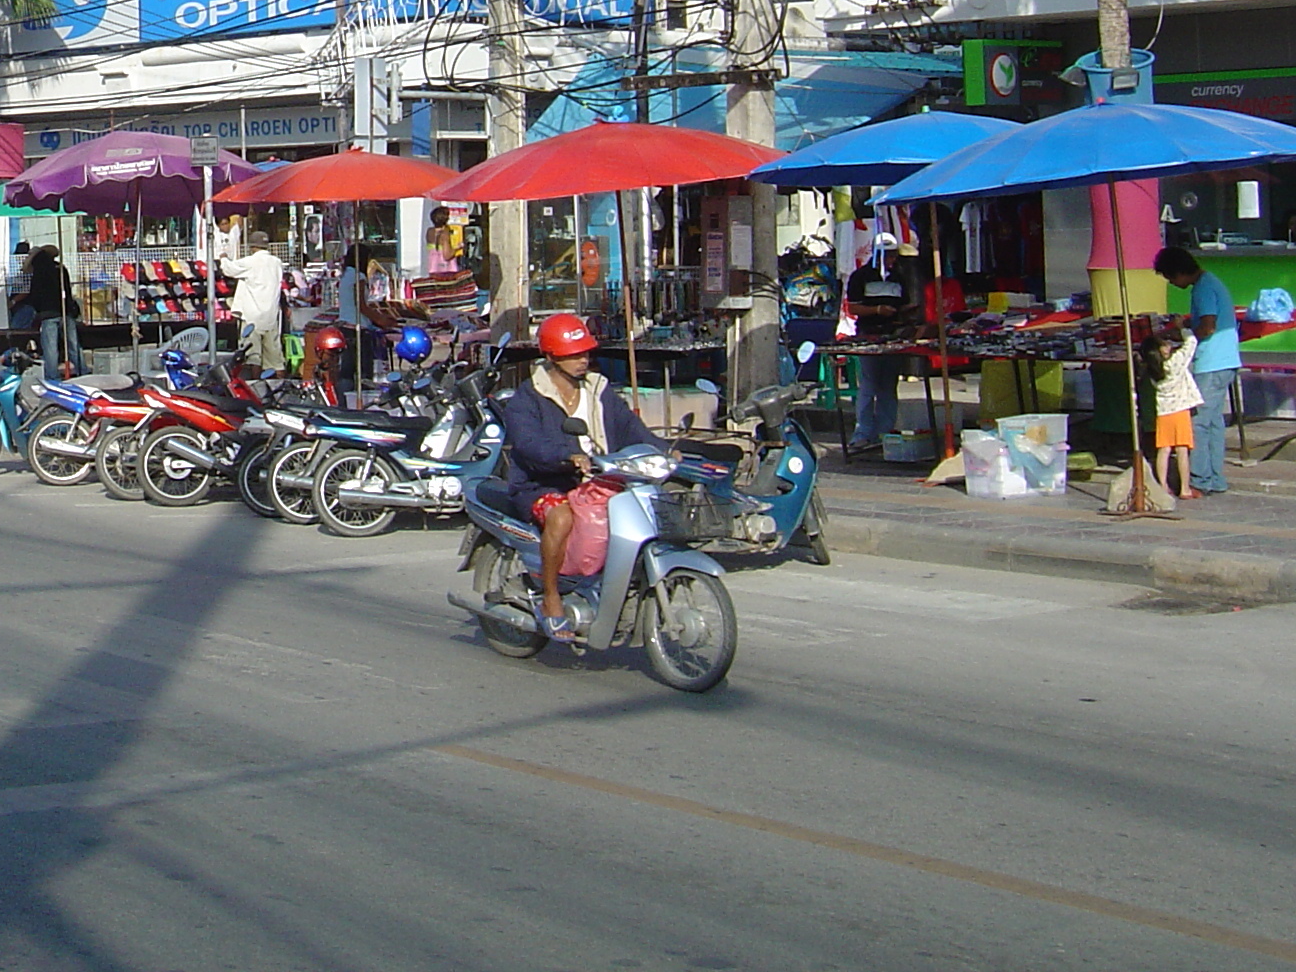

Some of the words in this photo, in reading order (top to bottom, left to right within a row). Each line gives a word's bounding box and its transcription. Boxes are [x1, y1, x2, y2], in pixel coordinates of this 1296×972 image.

[1191, 84, 1244, 98] currency
[184, 124, 211, 138] TOP
[218, 119, 292, 137] CHAROEN
